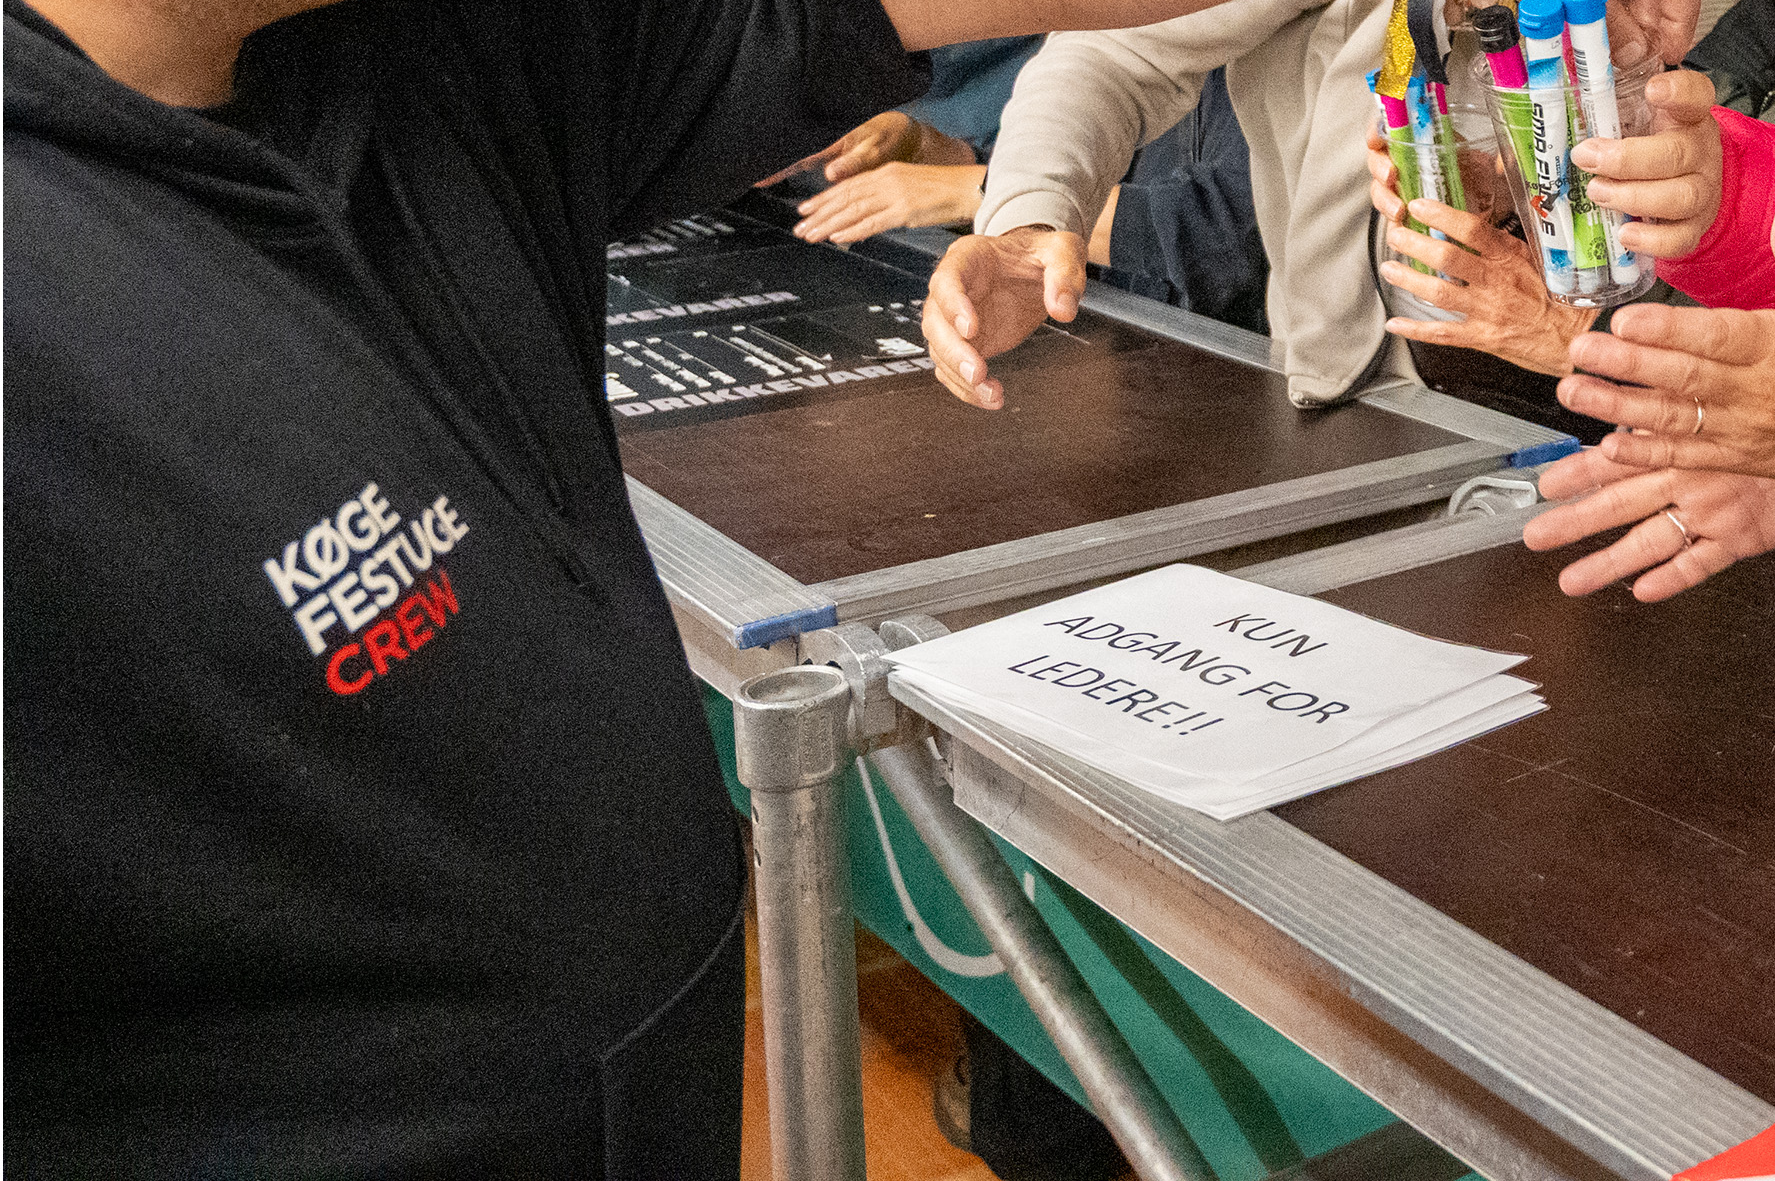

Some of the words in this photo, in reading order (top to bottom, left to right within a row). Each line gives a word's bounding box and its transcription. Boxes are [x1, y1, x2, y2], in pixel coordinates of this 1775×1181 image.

[606, 291, 800, 326] KEVARER
[263, 480, 401, 607] KØGE
[293, 494, 471, 656] FESTUGE
[325, 569, 460, 696] CREW
[1043, 615, 1252, 687] ADGANG
[1239, 680, 1350, 725] FOR
[1213, 613, 1329, 658] KUN
[1007, 654, 1225, 736] LEDERE!!
